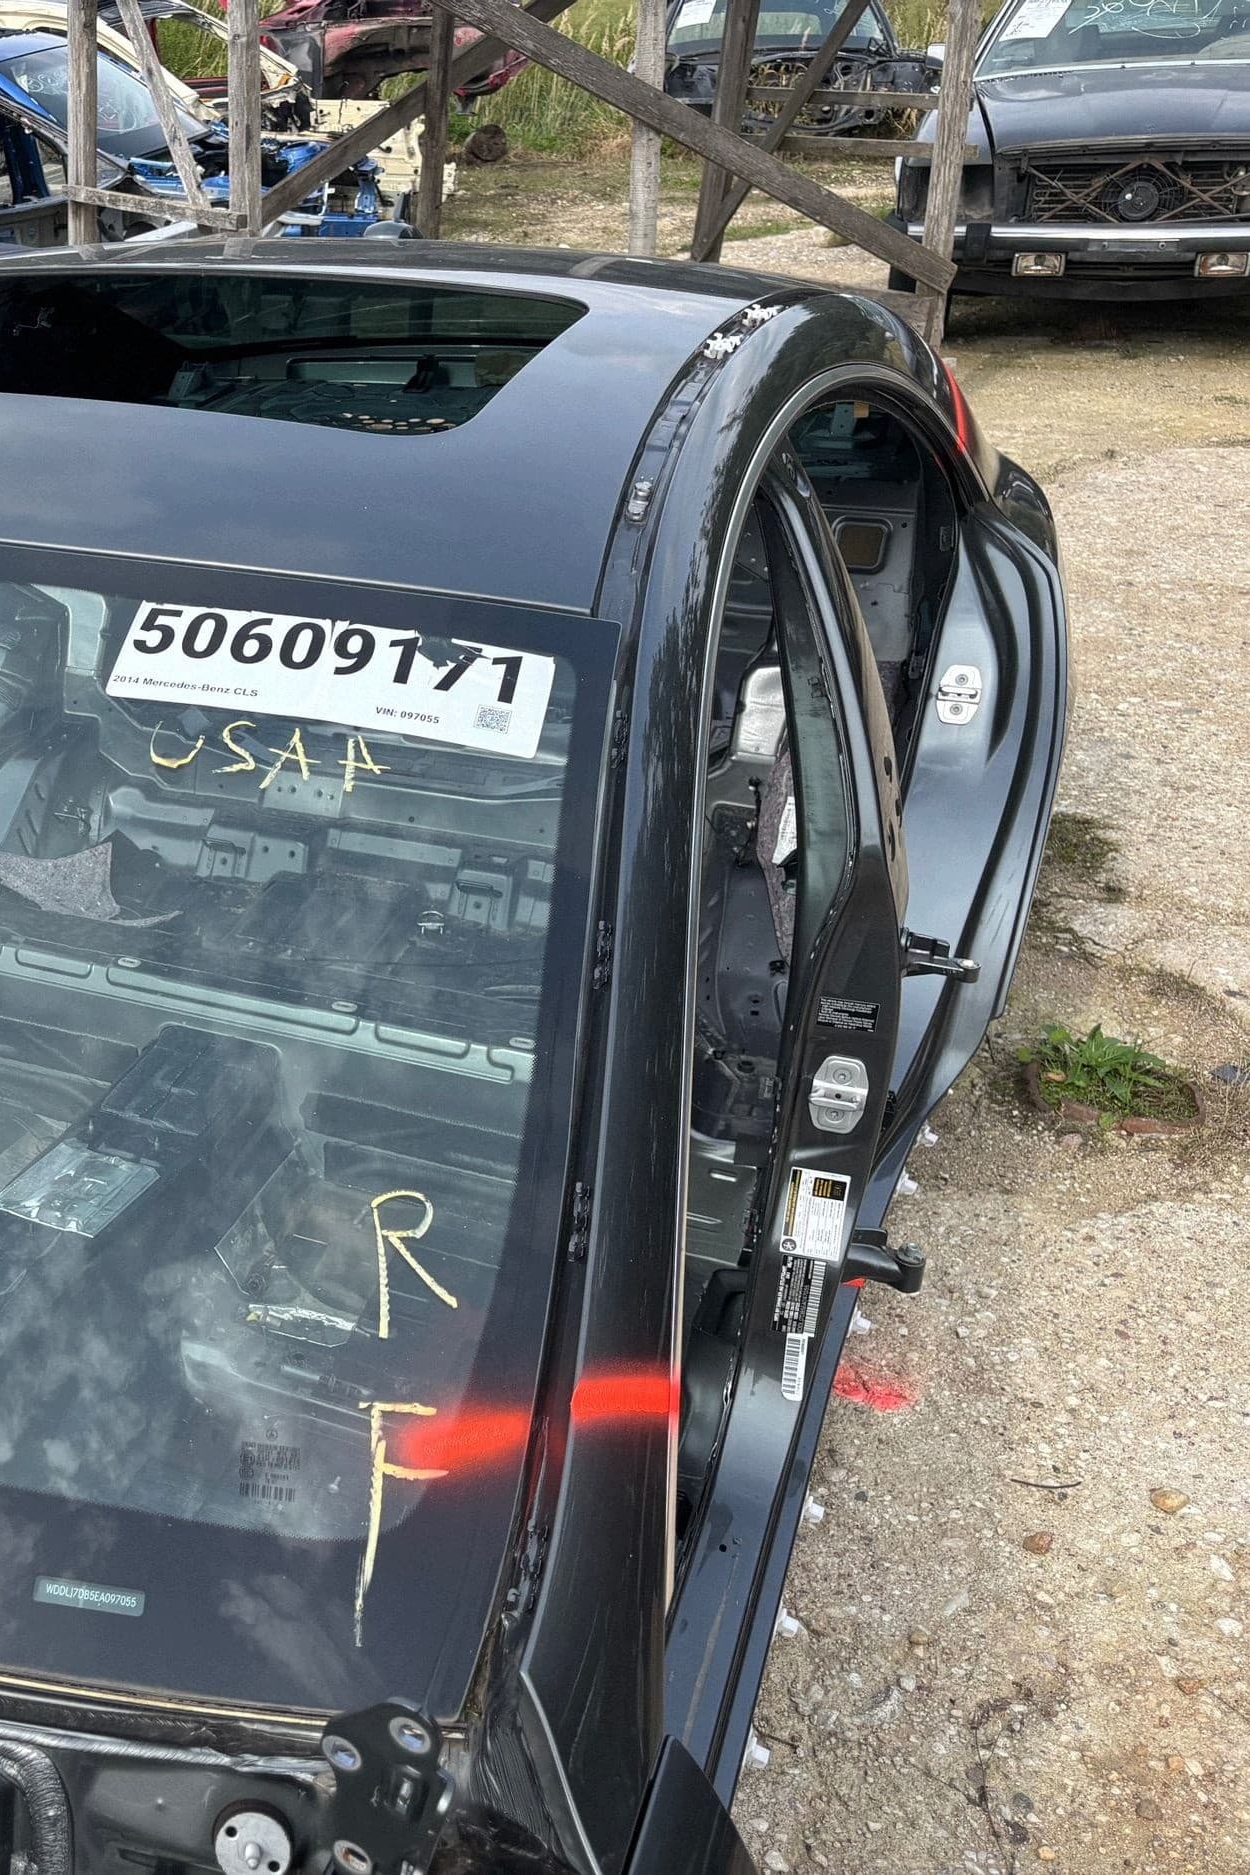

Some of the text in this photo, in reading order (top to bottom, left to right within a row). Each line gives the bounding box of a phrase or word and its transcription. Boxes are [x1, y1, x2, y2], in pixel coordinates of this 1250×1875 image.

[112, 674, 259, 697] 2014 Mercedes-Benz CLS
[133, 607, 523, 704] 50609171
[375, 706, 440, 724] VIN: 097055
[371, 1190, 457, 1338] R
